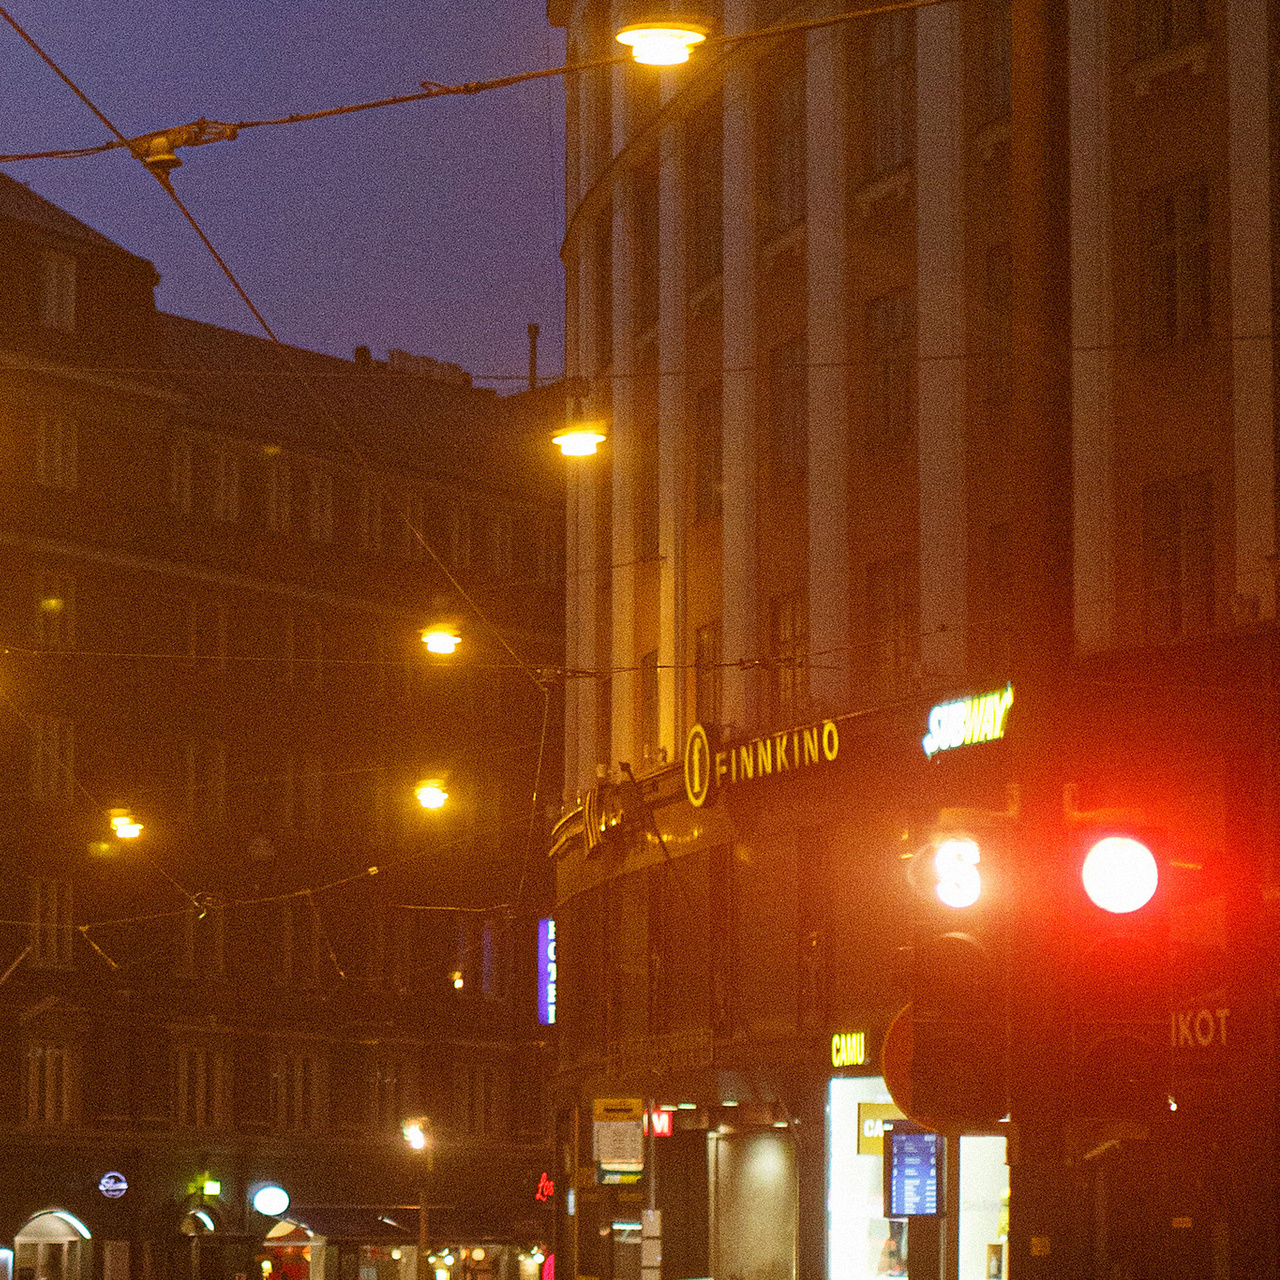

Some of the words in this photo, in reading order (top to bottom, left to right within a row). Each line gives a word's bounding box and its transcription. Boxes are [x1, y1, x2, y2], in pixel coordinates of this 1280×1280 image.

[922, 685, 1013, 756] SUBWAY
[716, 721, 839, 787] FINNKINO
[831, 1032, 865, 1067] CAMU
